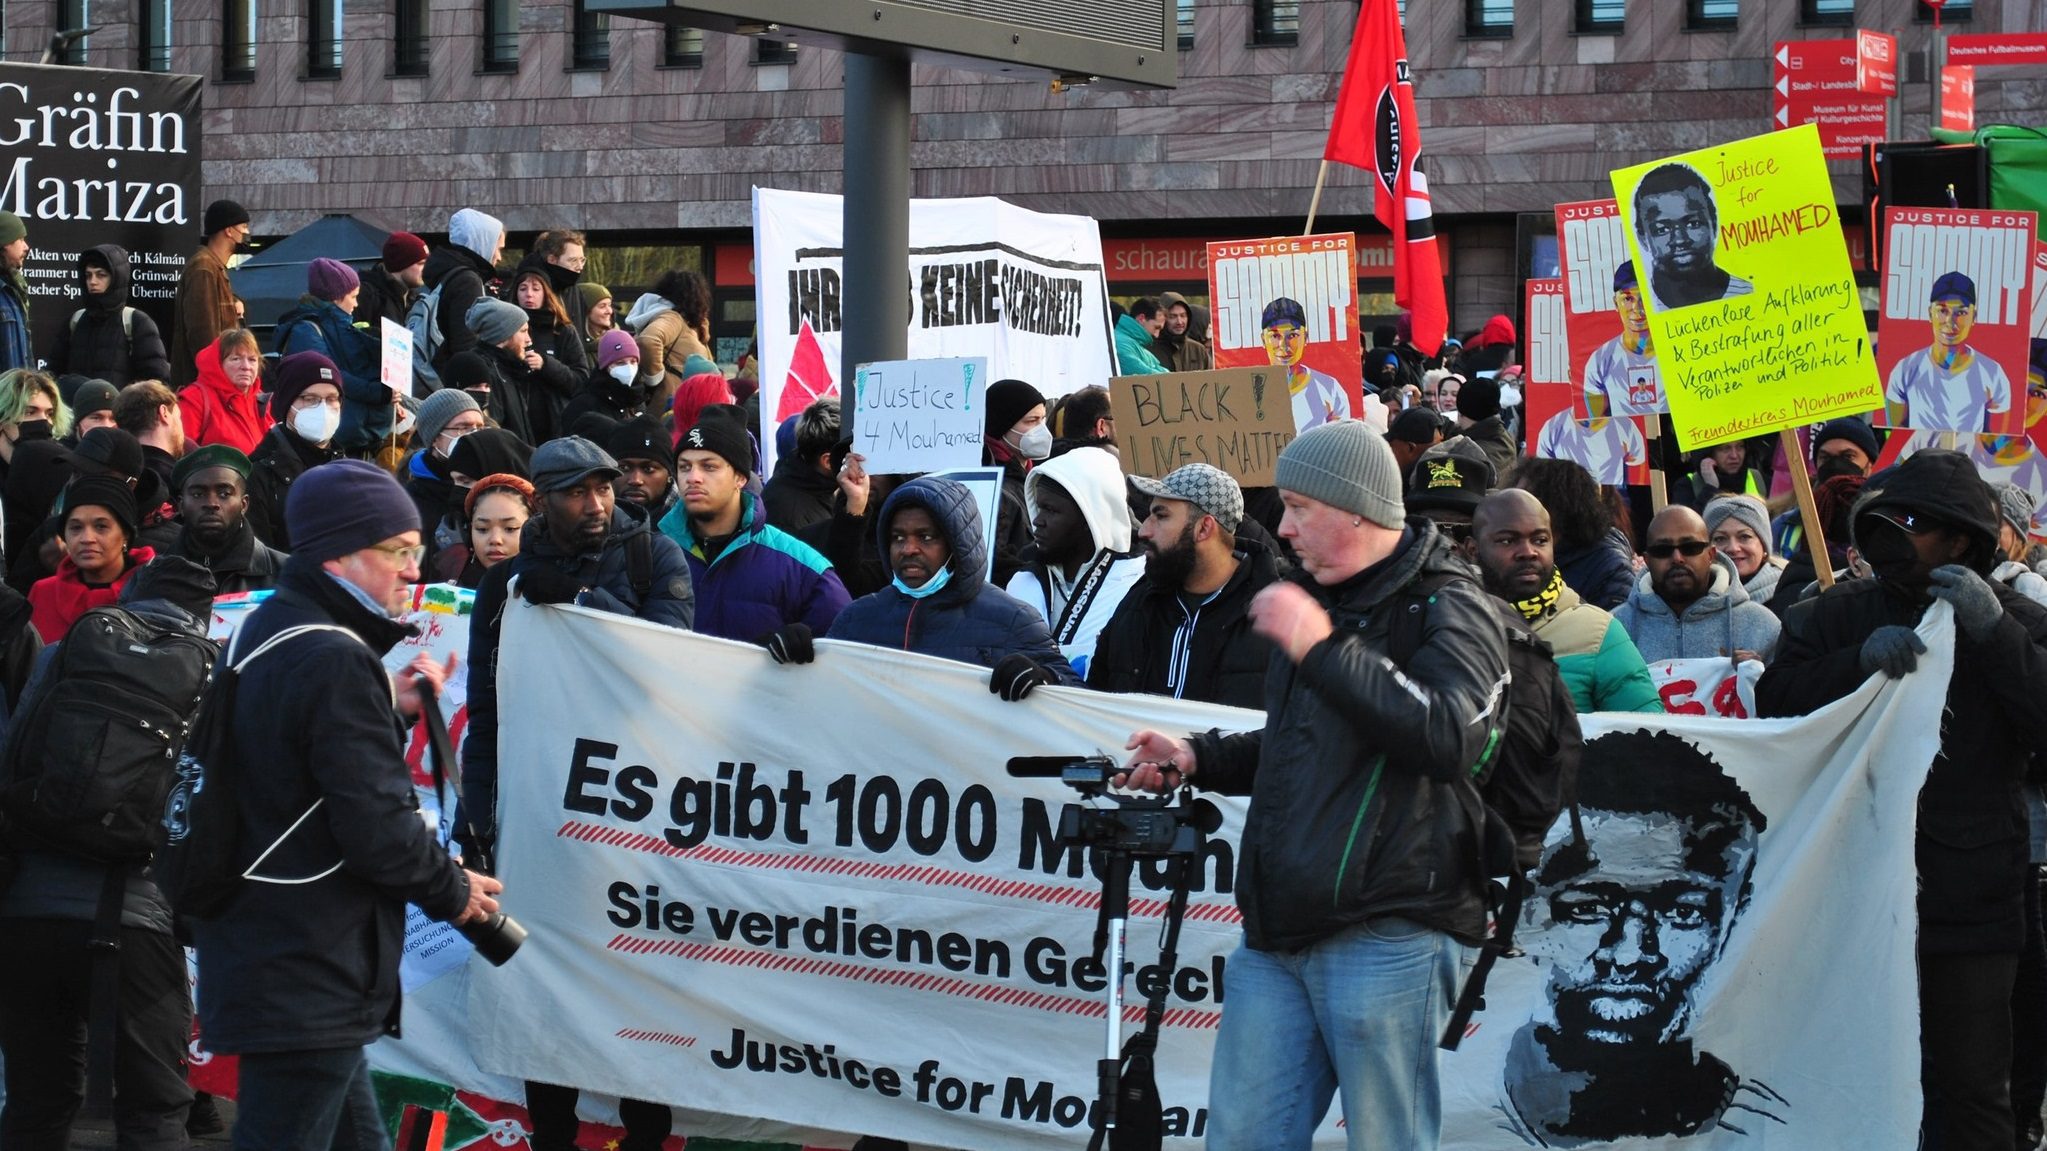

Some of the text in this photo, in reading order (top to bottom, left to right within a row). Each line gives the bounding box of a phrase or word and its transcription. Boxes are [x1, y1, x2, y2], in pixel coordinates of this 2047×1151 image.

[0, 82, 187, 154] Gräfin
[1813, 105, 1846, 114] Museum
[1861, 103, 1884, 112] Kunst
[1822, 145, 1862, 154] erzentrum
[1715, 158, 1780, 188] Justice
[1737, 186, 1764, 208] for
[1721, 203, 1831, 251] MOUHAMED
[1894, 212, 2029, 228] JUSTICE FOR
[26, 248, 59, 261] Akten
[144, 252, 186, 265] Kálmán
[1216, 239, 1348, 257] JUSTICE FOR
[27, 283, 61, 295] tscher
[1885, 224, 2028, 326] SAMMY
[788, 267, 841, 335] IHR
[921, 259, 999, 329] KEINE
[1001, 263, 1083, 338] SICHERHEIT!
[1215, 250, 1351, 350] SAMMY
[1666, 304, 1755, 339] Lückenlose
[1690, 323, 1784, 361] Bestrafung
[1792, 312, 1835, 334] aller
[1825, 332, 1850, 348] in
[1757, 365, 1786, 384] und
[1790, 351, 1847, 375] Politik
[868, 370, 954, 410] Justice
[1132, 379, 1238, 427] BLACK
[1688, 408, 1786, 442] Freundeskreis
[1793, 384, 1879, 417] Mouhamed
[865, 418, 982, 452] 4 Mouhamed
[1130, 434, 1211, 479] LIVES
[563, 737, 658, 823] Es
[663, 761, 811, 850] gibt
[825, 773, 997, 863] 1000
[420, 936, 454, 960] MISSION
[606, 880, 694, 934] Sie
[706, 905, 1010, 979] verdienen
[710, 1028, 901, 1098] Justice
[913, 1060, 994, 1114] for
